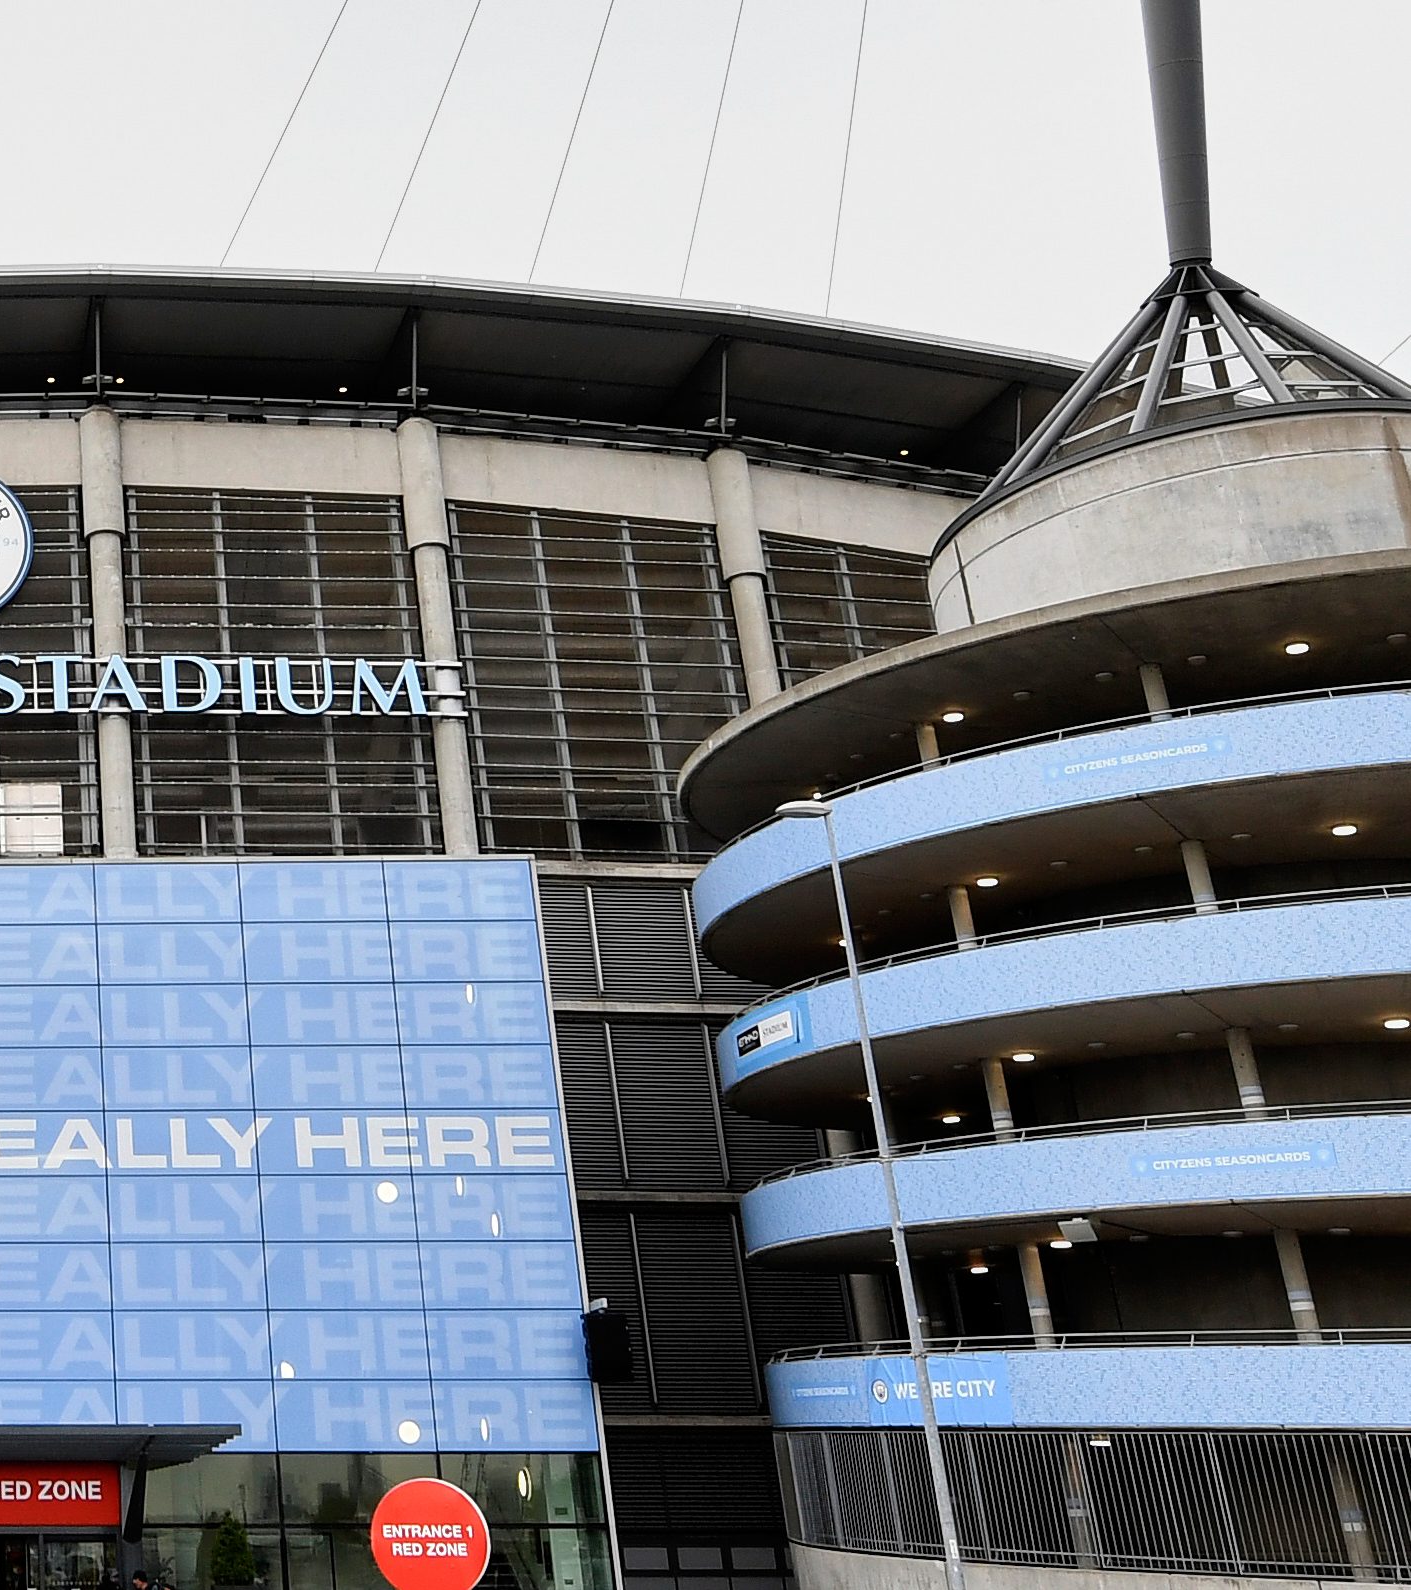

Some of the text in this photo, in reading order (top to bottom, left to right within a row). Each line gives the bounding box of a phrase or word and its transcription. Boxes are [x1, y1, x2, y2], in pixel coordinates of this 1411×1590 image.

[1064, 743, 1208, 774] CITYZENS SEASONCARDS
[278, 869, 528, 918] HERE
[283, 928, 534, 978] HERE
[287, 990, 538, 1040] HERE
[290, 1053, 545, 1104] HERE
[293, 1116, 555, 1168] HERE
[1153, 1151, 1311, 1170] CITYZENS SEASONCARDS
[299, 1182, 565, 1234] HERE
[303, 1248, 576, 1301] HERE
[309, 1318, 585, 1371] HERE
[894, 1380, 996, 1399] WE RE CITY
[313, 1386, 587, 1444] HERE
[38, 1480, 102, 1500] ZONE
[383, 1525, 473, 1538] ENTRANCE 1
[392, 1542, 468, 1557] RED ZONE
